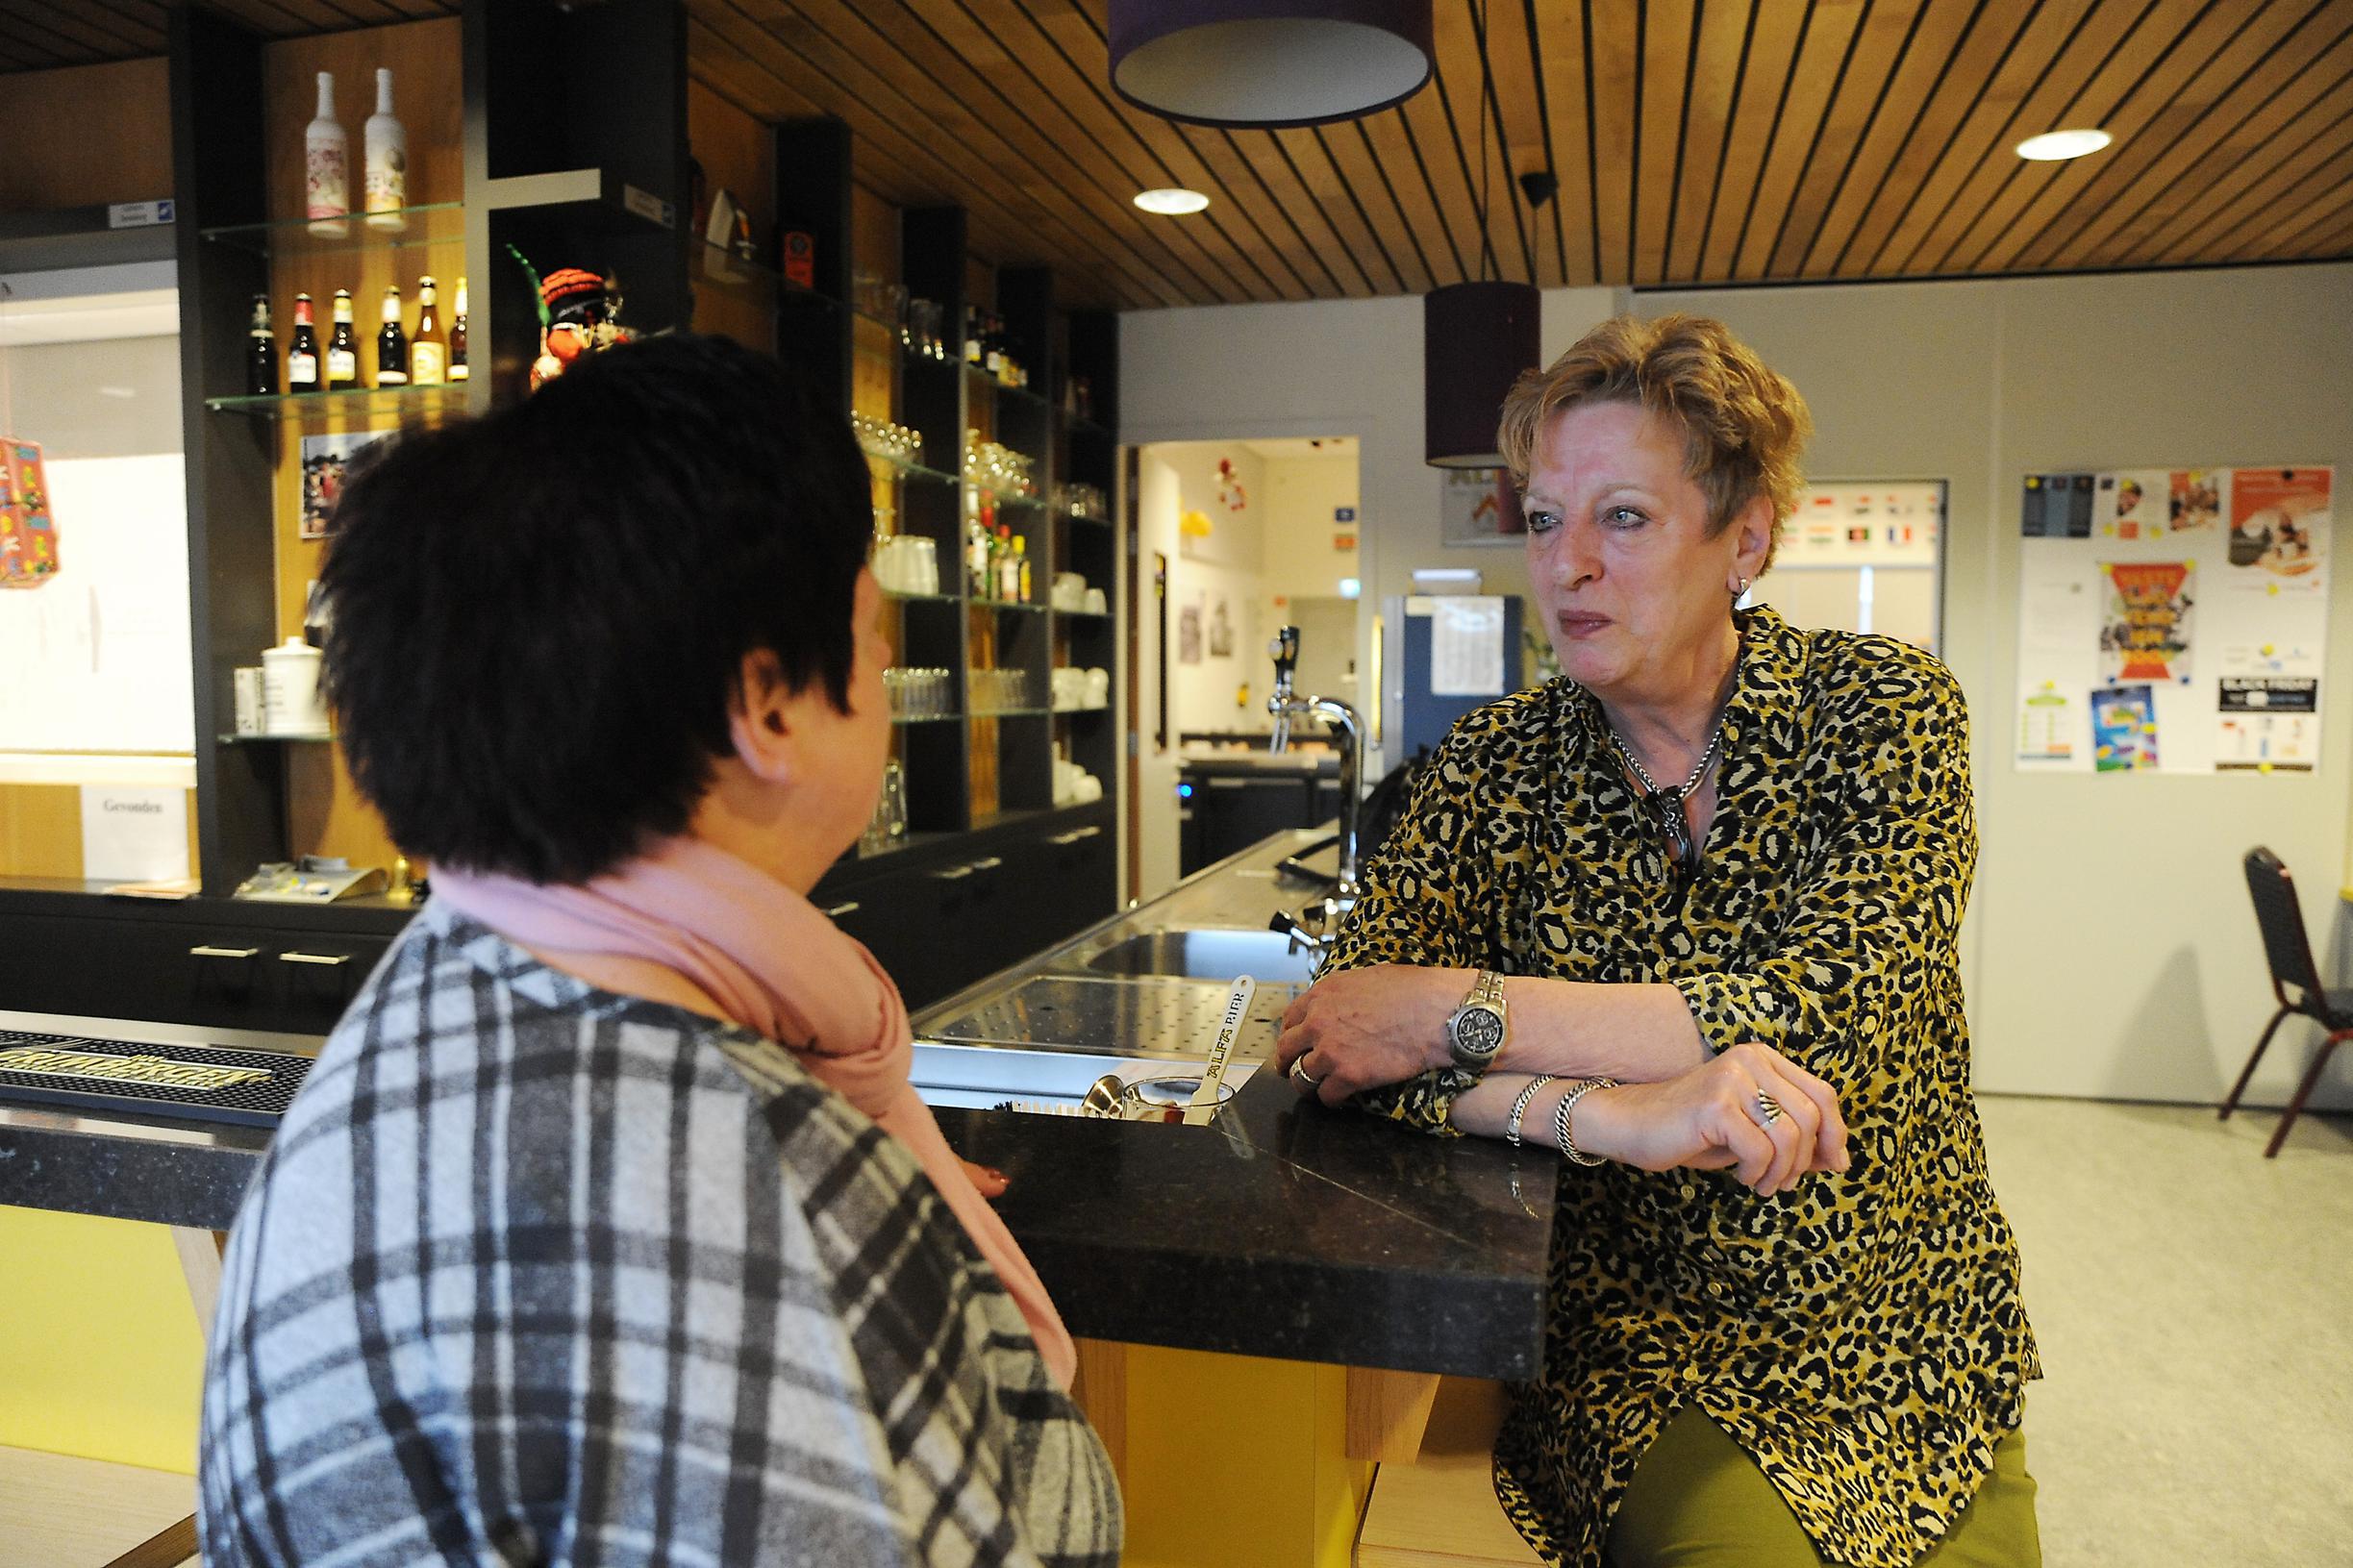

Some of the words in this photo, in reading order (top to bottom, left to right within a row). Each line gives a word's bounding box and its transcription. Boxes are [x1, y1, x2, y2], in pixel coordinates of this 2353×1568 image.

[103, 798, 163, 813] Gevonden
[0, 1050, 261, 1084] GRIMBERGEN
[1206, 1028, 1233, 1079] ALFA
